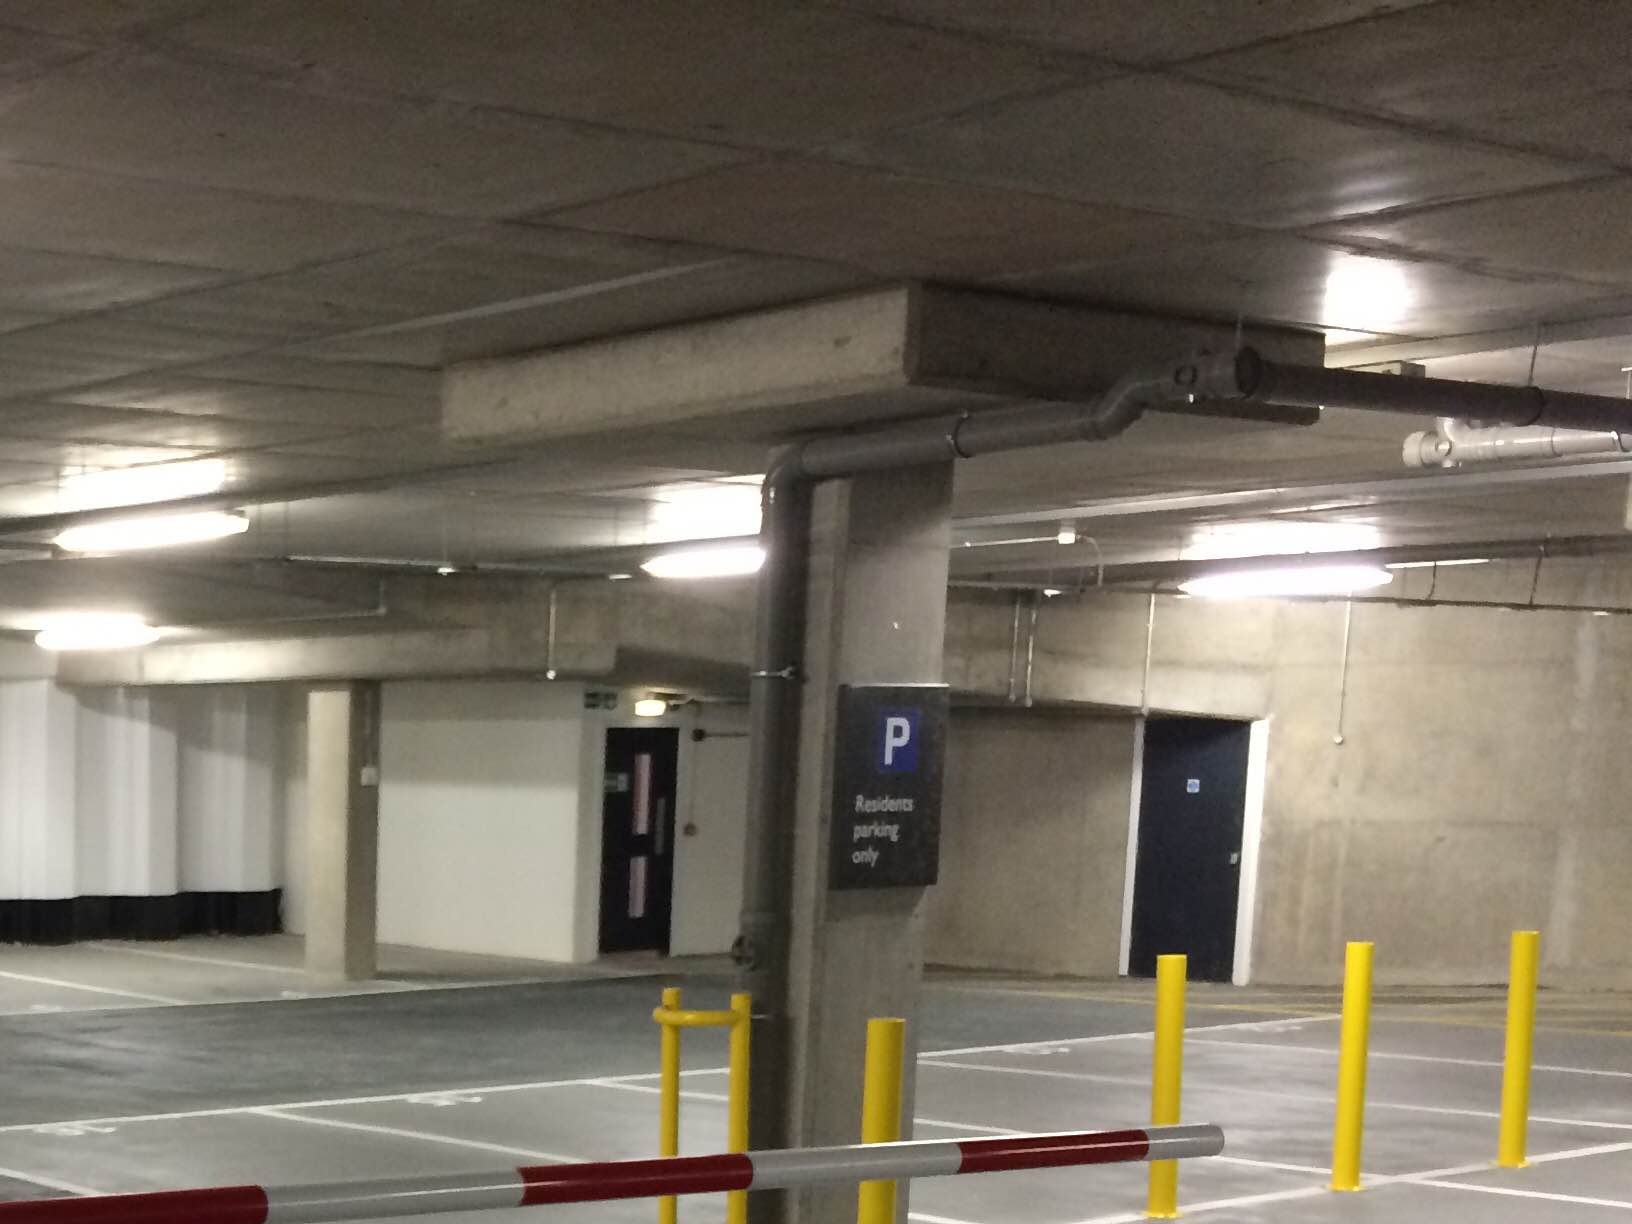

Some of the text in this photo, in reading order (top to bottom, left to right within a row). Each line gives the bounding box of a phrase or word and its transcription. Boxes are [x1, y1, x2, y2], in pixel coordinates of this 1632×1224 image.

[884, 716, 911, 766] P
[855, 794, 914, 813] Residents
[853, 821, 900, 842] parking
[852, 845, 879, 867] only
